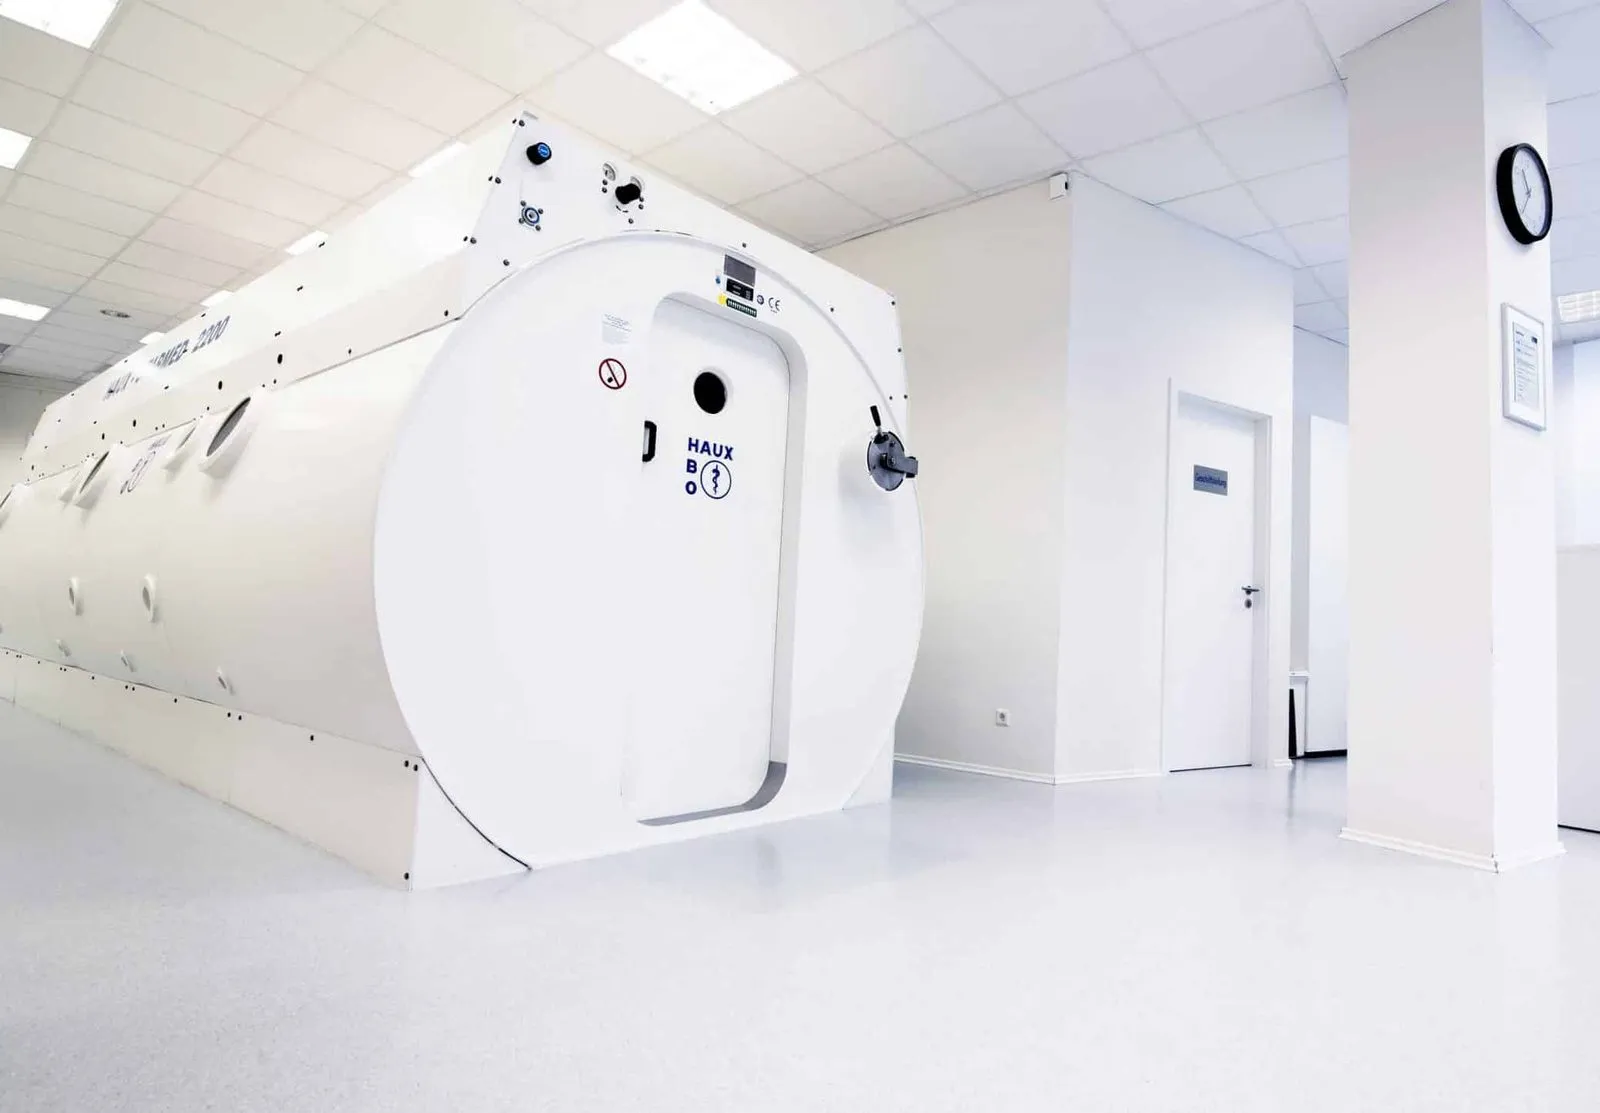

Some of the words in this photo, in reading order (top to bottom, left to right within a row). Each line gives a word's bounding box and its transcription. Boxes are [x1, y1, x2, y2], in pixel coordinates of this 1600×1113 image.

[687, 437, 734, 461] HAUX
[686, 459, 697, 474] B
[685, 480, 697, 495] O
